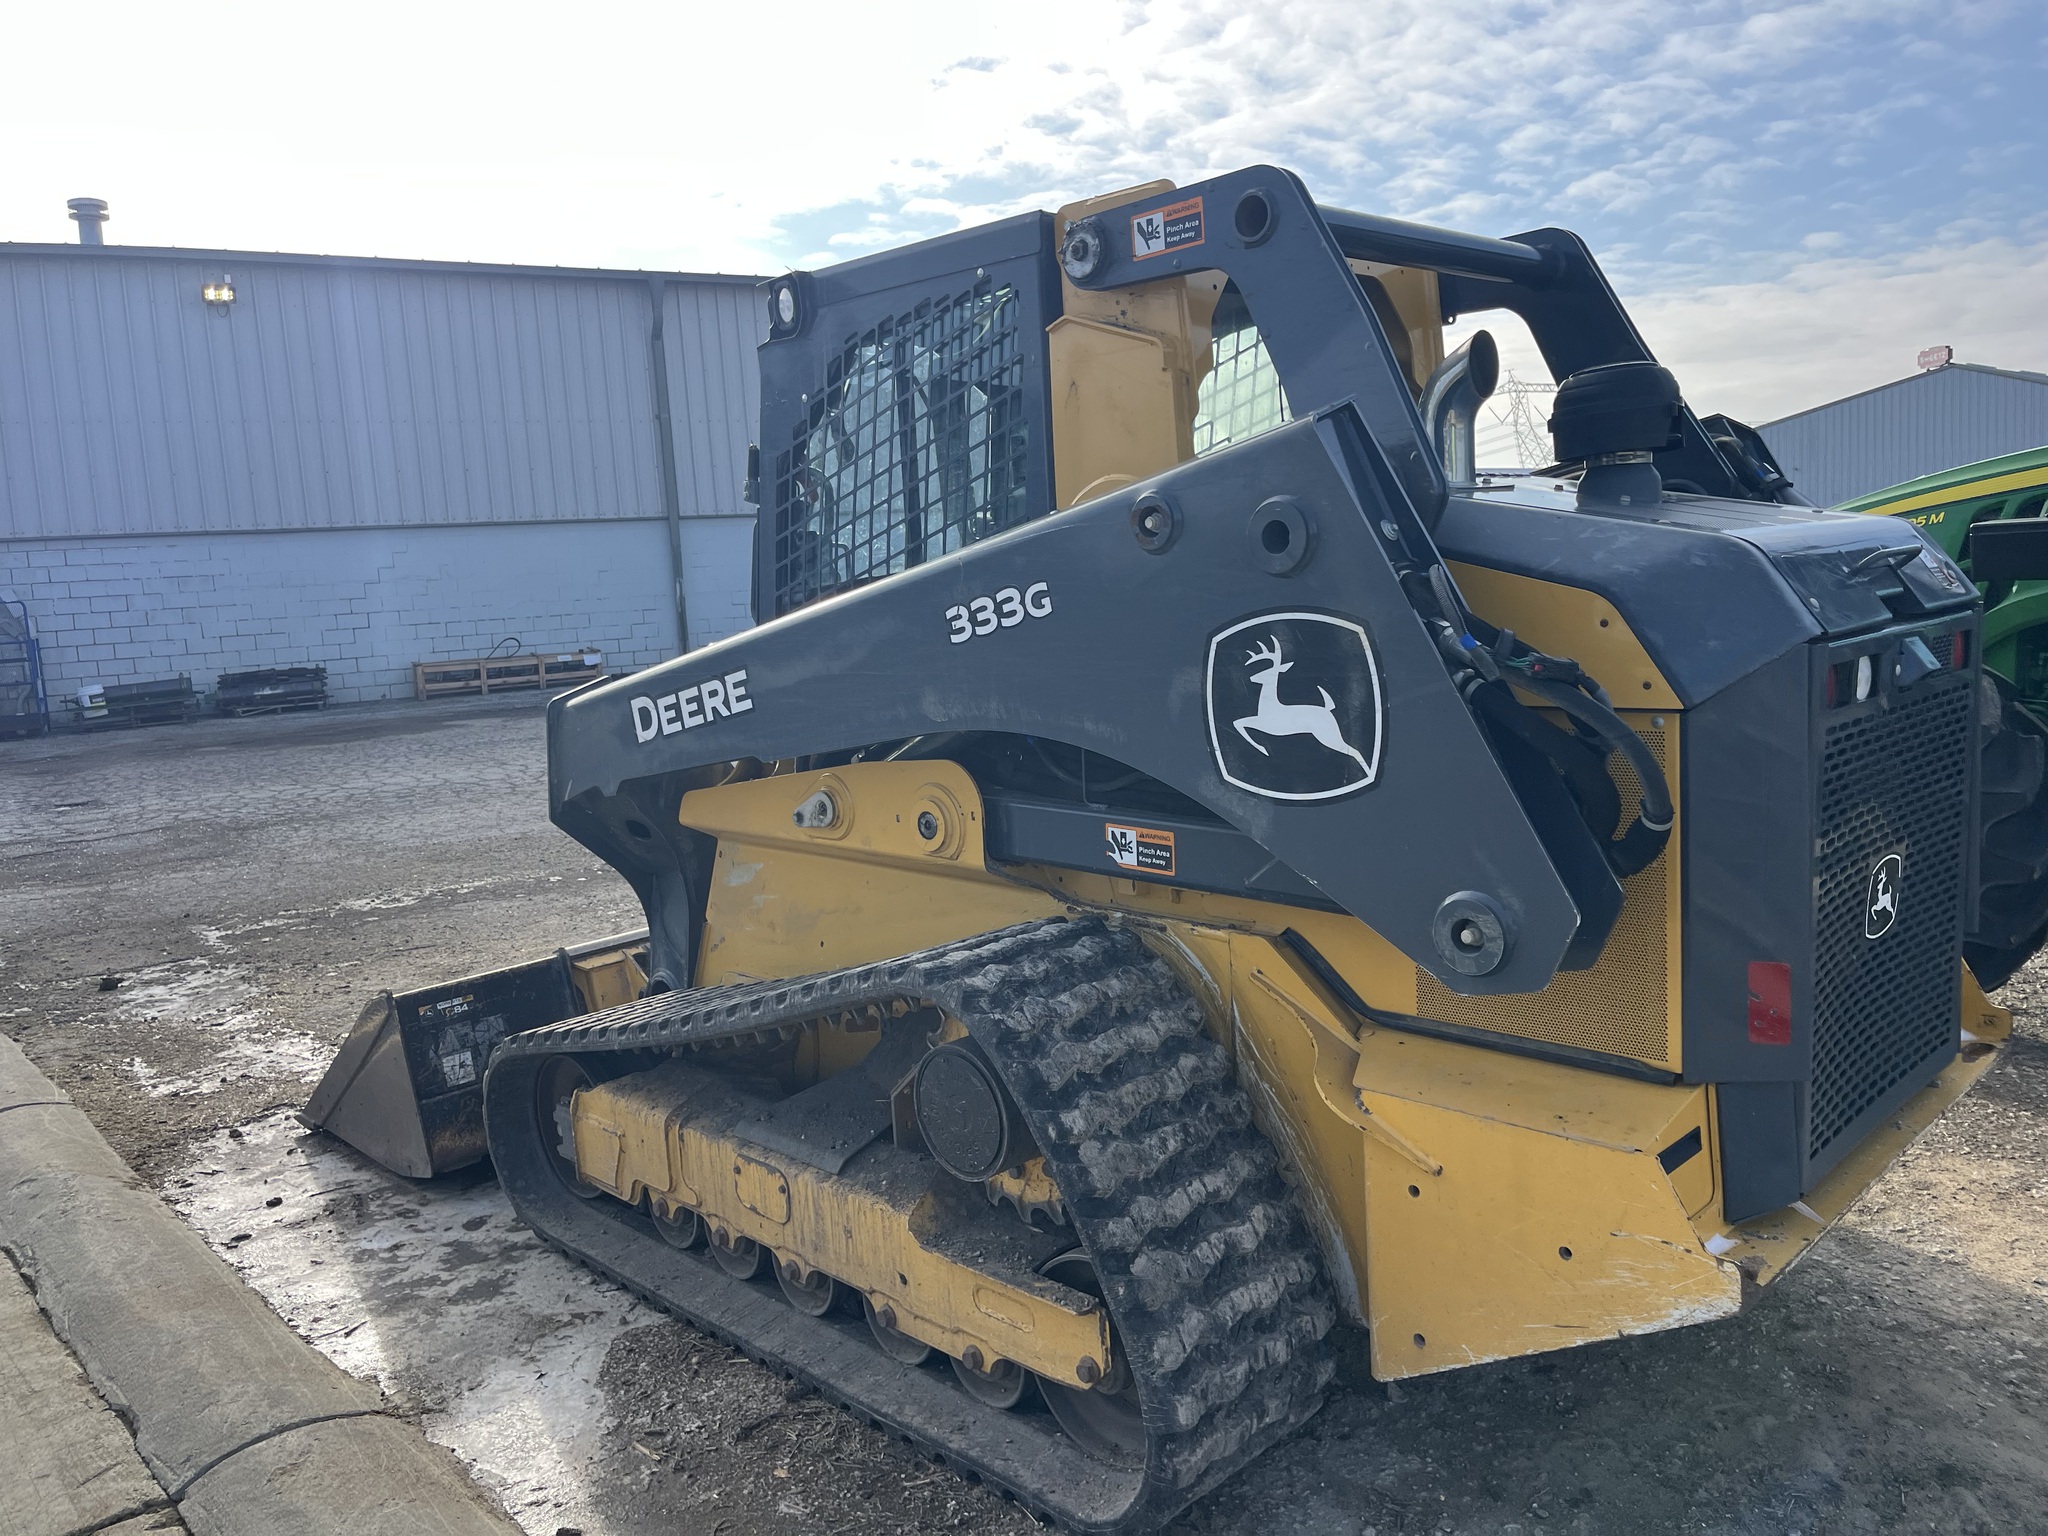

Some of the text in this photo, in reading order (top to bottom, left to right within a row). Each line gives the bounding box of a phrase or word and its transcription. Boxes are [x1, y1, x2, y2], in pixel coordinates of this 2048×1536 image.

[1172, 201, 1200, 214] WARNING
[1166, 220, 1200, 234] Pinch Area
[1166, 234, 1181, 243] Keep
[1181, 231, 1196, 240] Away
[1928, 511, 1946, 525] M
[945, 582, 1053, 643] 333G
[630, 669, 753, 744] DEERE
[1144, 833, 1171, 842] WARNING
[1138, 846, 1171, 858] Pinch Area
[1138, 855, 1166, 867] Keep Away
